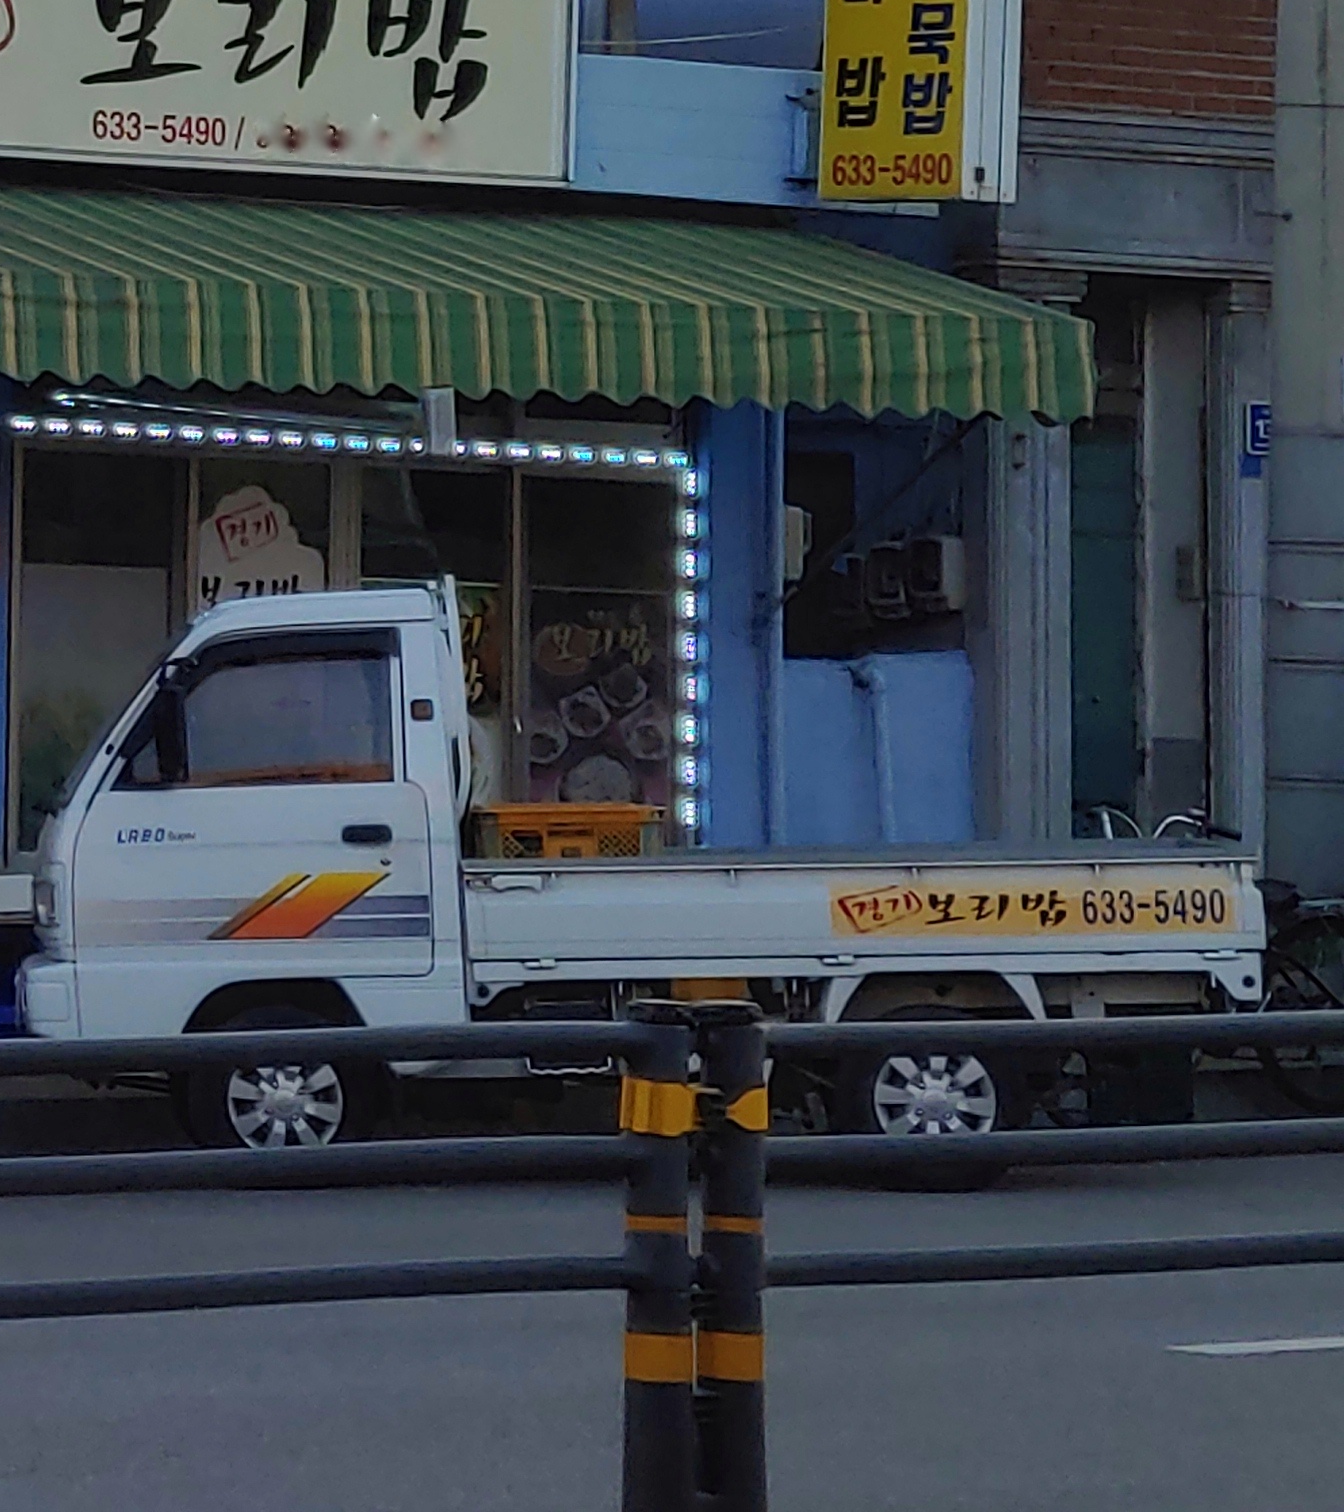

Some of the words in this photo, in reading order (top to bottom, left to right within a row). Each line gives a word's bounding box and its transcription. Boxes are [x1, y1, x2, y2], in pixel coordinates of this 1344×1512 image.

[92, 109, 226, 147] 633-5490
[832, 153, 953, 187] 633-5490
[116, 828, 166, 845] LABO
[924, 890, 1067, 927] 보리밥
[1081, 888, 1226, 925] 633-5490
